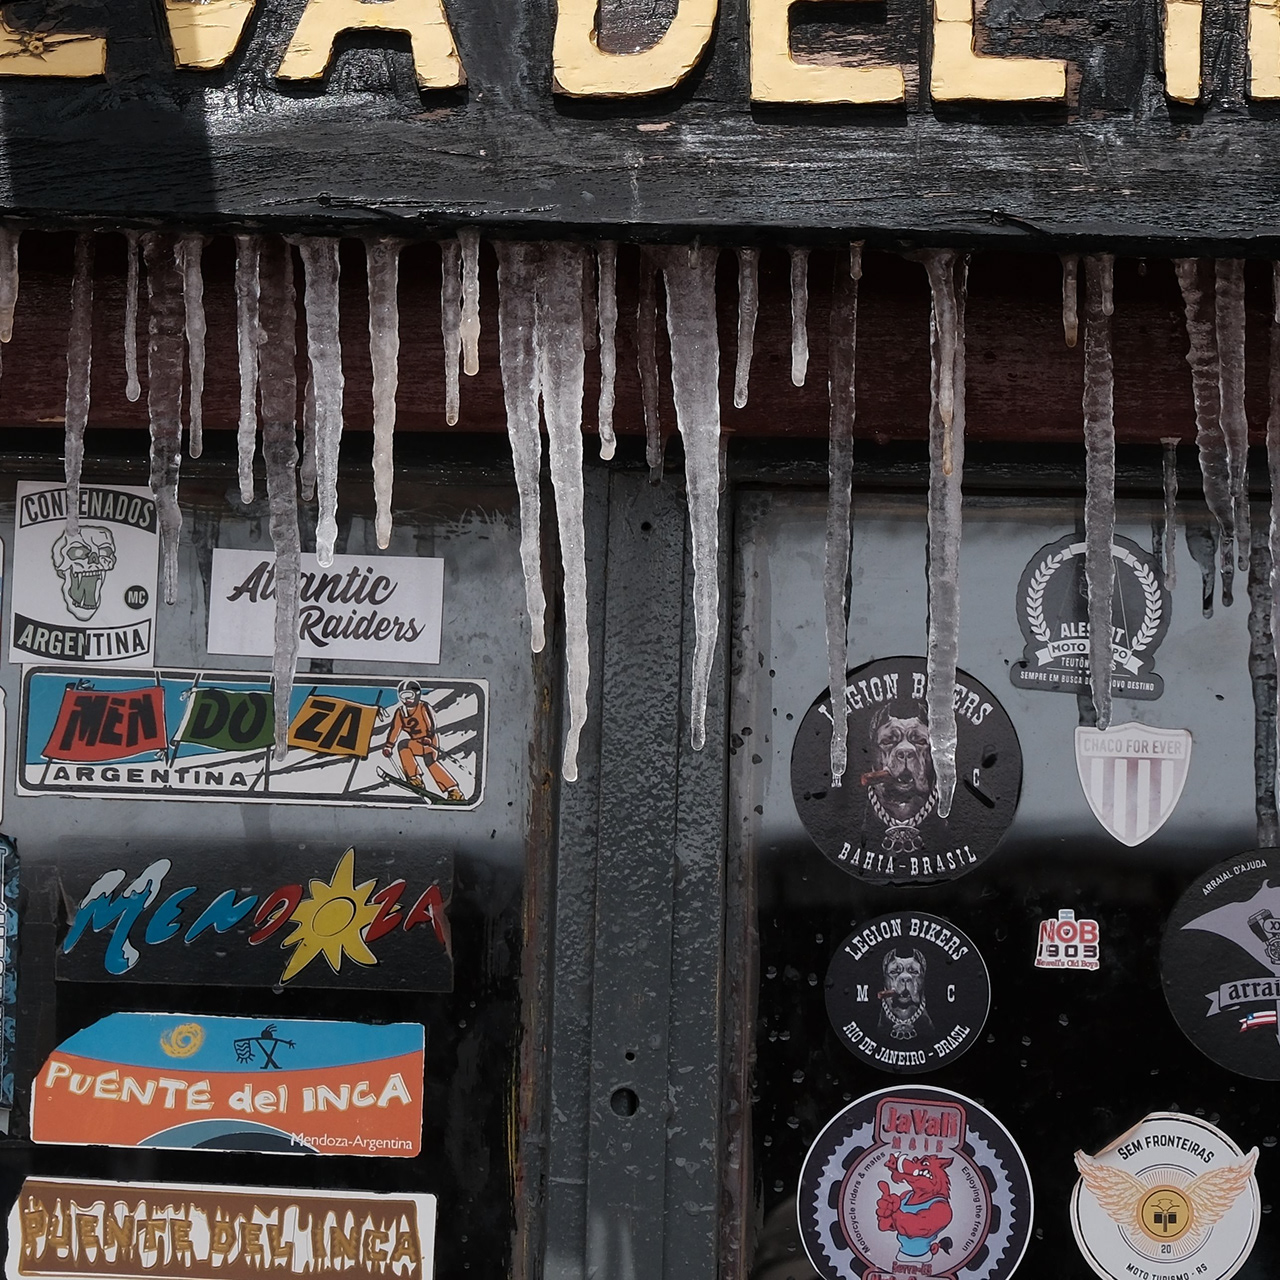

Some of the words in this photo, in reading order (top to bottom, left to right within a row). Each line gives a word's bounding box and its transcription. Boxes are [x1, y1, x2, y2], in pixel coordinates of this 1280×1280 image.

[24, 490, 155, 527] CONENADOS
[226, 561, 398, 605] Atantic
[128, 591, 146, 603] MC
[299, 606, 426, 647] Raiders
[18, 625, 144, 657] ARGENTINA
[1052, 643, 1086, 653] MOTO
[1020, 671, 1047, 680] SEMPRE
[1049, 673, 1059, 682] EM
[1061, 674, 1082, 684] BUSCA
[1128, 680, 1154, 690] DESTINO
[60, 694, 162, 751] MEN
[189, 691, 266, 744] DO
[293, 701, 358, 748] ZA
[1084, 738, 1122, 752] CHACO
[1126, 740, 1148, 753] FOR
[1153, 741, 1181, 754] EVER
[52, 768, 248, 786] ARGENTINA
[1202, 872, 1233, 896] ARRAIAL
[1234, 859, 1267, 876] D'AJUDA
[845, 919, 901, 961] LEGION
[910, 919, 969, 961] BIKERS
[1040, 921, 1098, 943] NOB
[1039, 944, 1097, 958] 1903
[1081, 960, 1098, 969] Boys
[857, 985, 868, 1002] M
[947, 985, 955, 1002] C
[843, 1021, 862, 1042] RIO
[859, 1037, 877, 1055] DE
[875, 1047, 926, 1065] JANEIRO
[934, 1025, 970, 1057] BRASIL
[45, 1061, 215, 1111] PUENTE
[228, 1084, 288, 1114] del
[302, 1073, 412, 1113] INCA
[883, 1107, 958, 1137] JaVali
[290, 1132, 412, 1150] Mendoza-Argentina
[1118, 1140, 1143, 1160] SEM
[1145, 1135, 1215, 1164] FRONTEIRAS
[864, 1151, 886, 1172] mates
[851, 1177, 861, 1204] riders
[962, 1166, 980, 1202] Enjoying
[974, 1203, 982, 1219] the
[23, 1203, 193, 1263] PUENTE
[214, 1214, 295, 1264] DEL
[315, 1217, 419, 1268] INCA
[849, 1206, 870, 1254] Motorcycle
[971, 1221, 981, 1239] free
[962, 1239, 974, 1251] fun
[1161, 1244, 1171, 1254] 20
[1126, 1263, 1149, 1280] MOTO
[1195, 1263, 1208, 1276] RS
